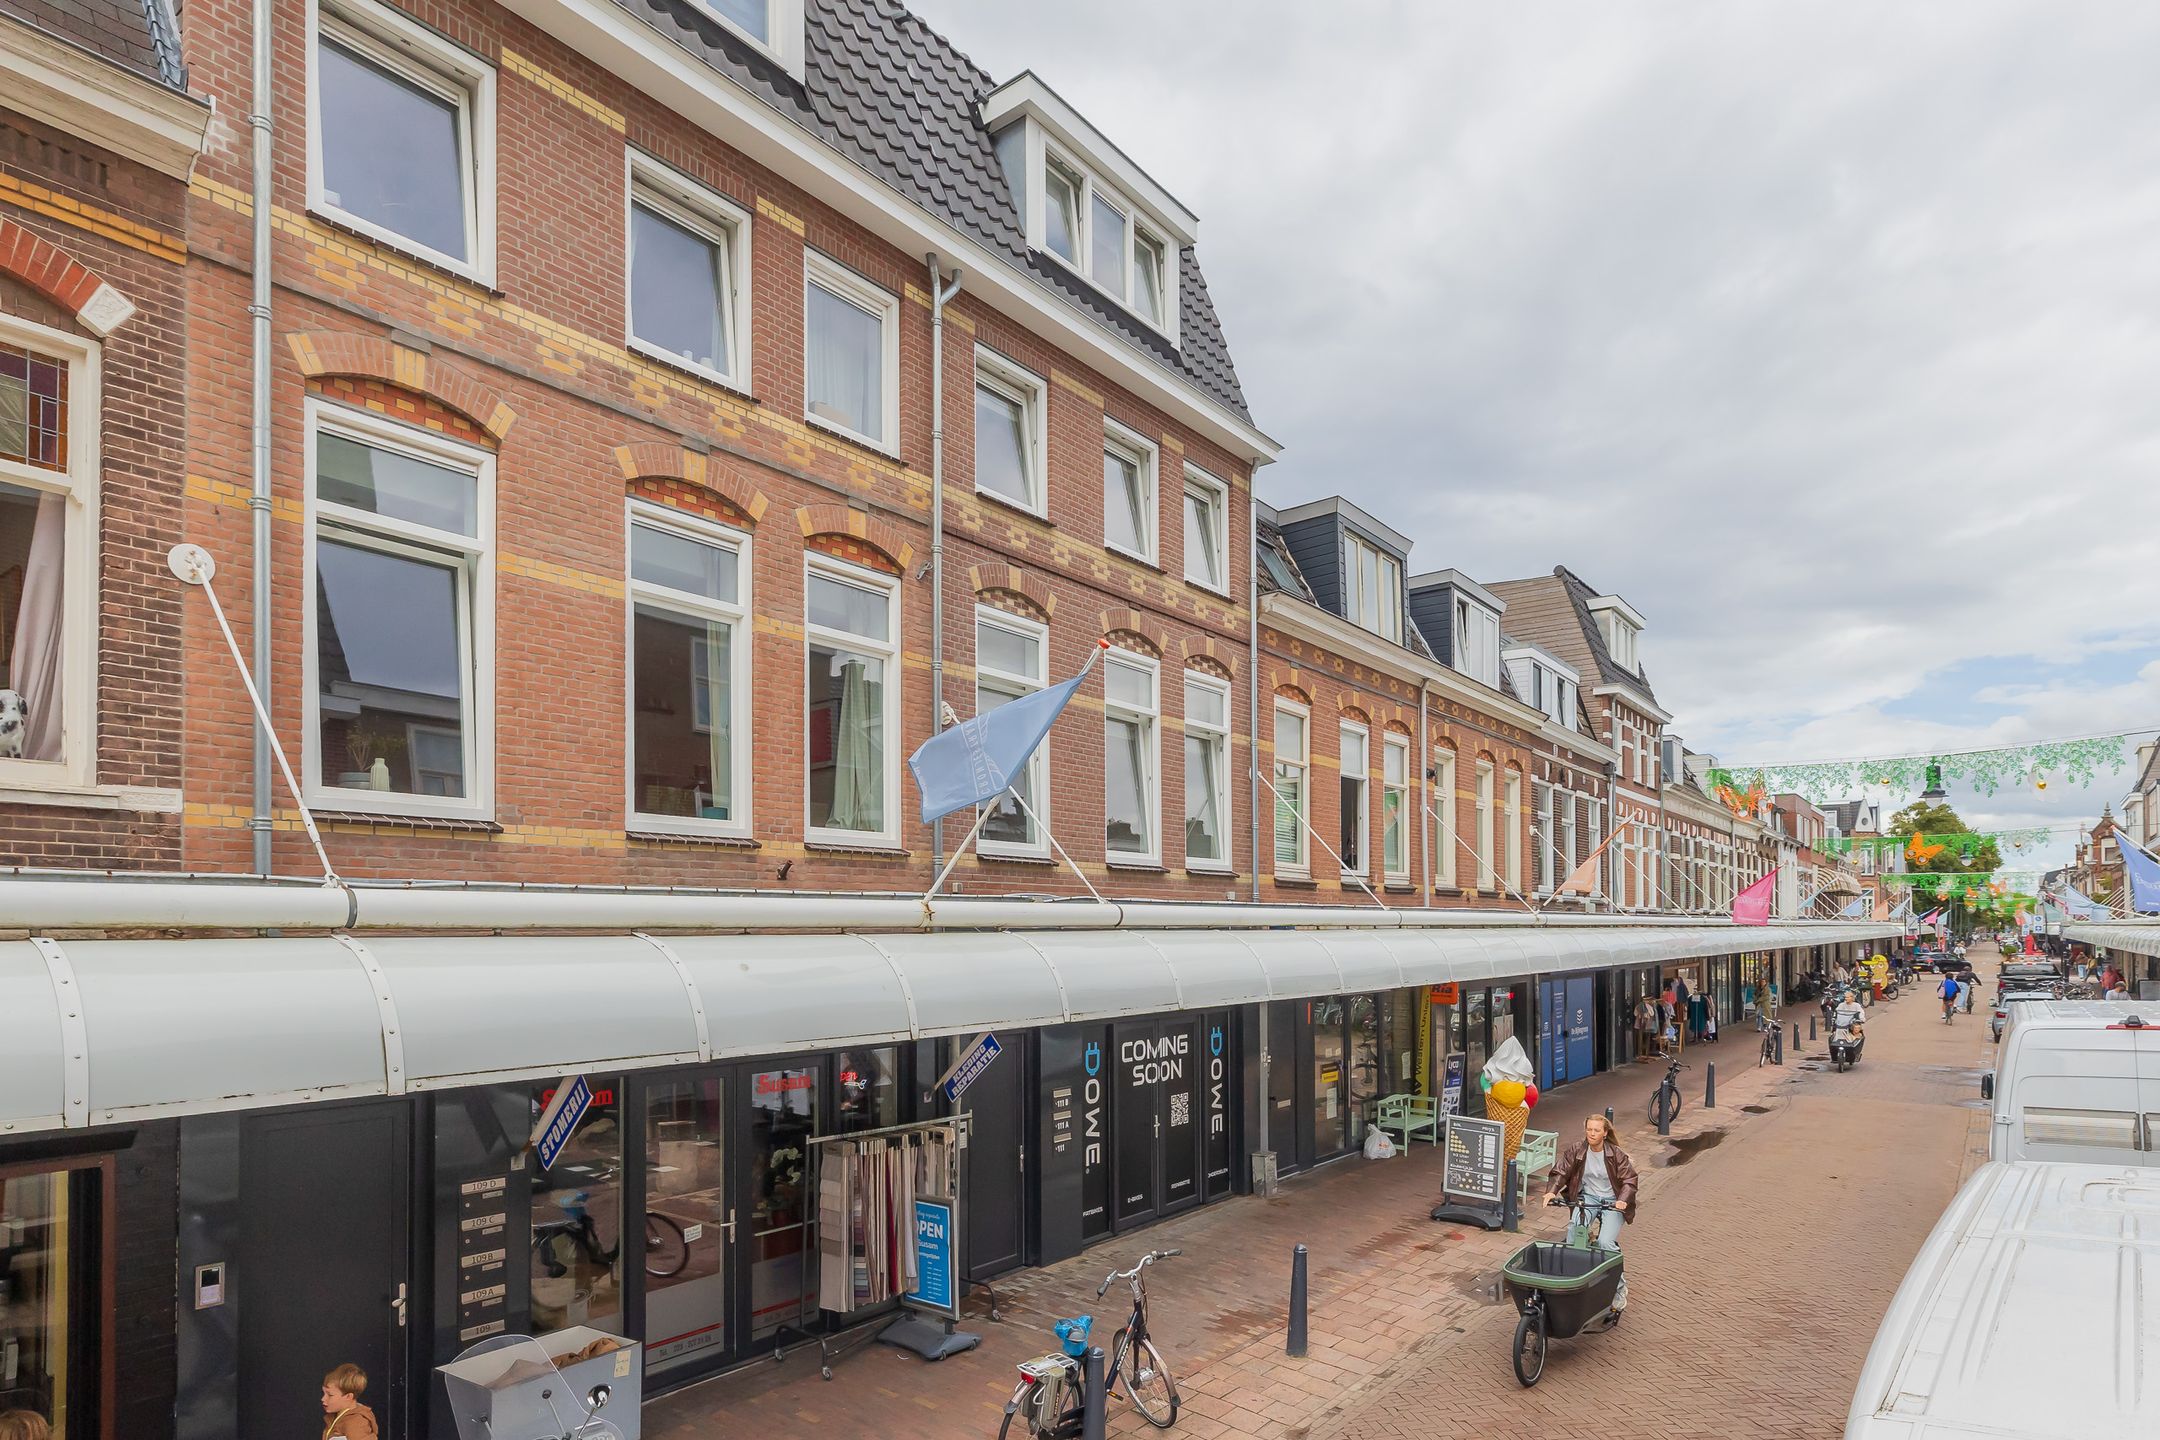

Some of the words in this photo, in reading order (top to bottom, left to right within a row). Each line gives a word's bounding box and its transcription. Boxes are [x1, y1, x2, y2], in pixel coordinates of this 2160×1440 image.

[1121, 1034, 1188, 1063] COMING
[951, 1046, 997, 1096] REPARATIE
[953, 1044, 987, 1084] KLEDING
[1132, 1058, 1182, 1087] SOON
[756, 1074, 812, 1095] Susam
[541, 1083, 586, 1161] STOMERIJ
[472, 1182, 488, 1191] 109
[472, 1217, 487, 1228] 109
[472, 1254, 487, 1264] 109
[472, 1290, 487, 1300] 109
[475, 1325, 491, 1335] 109
